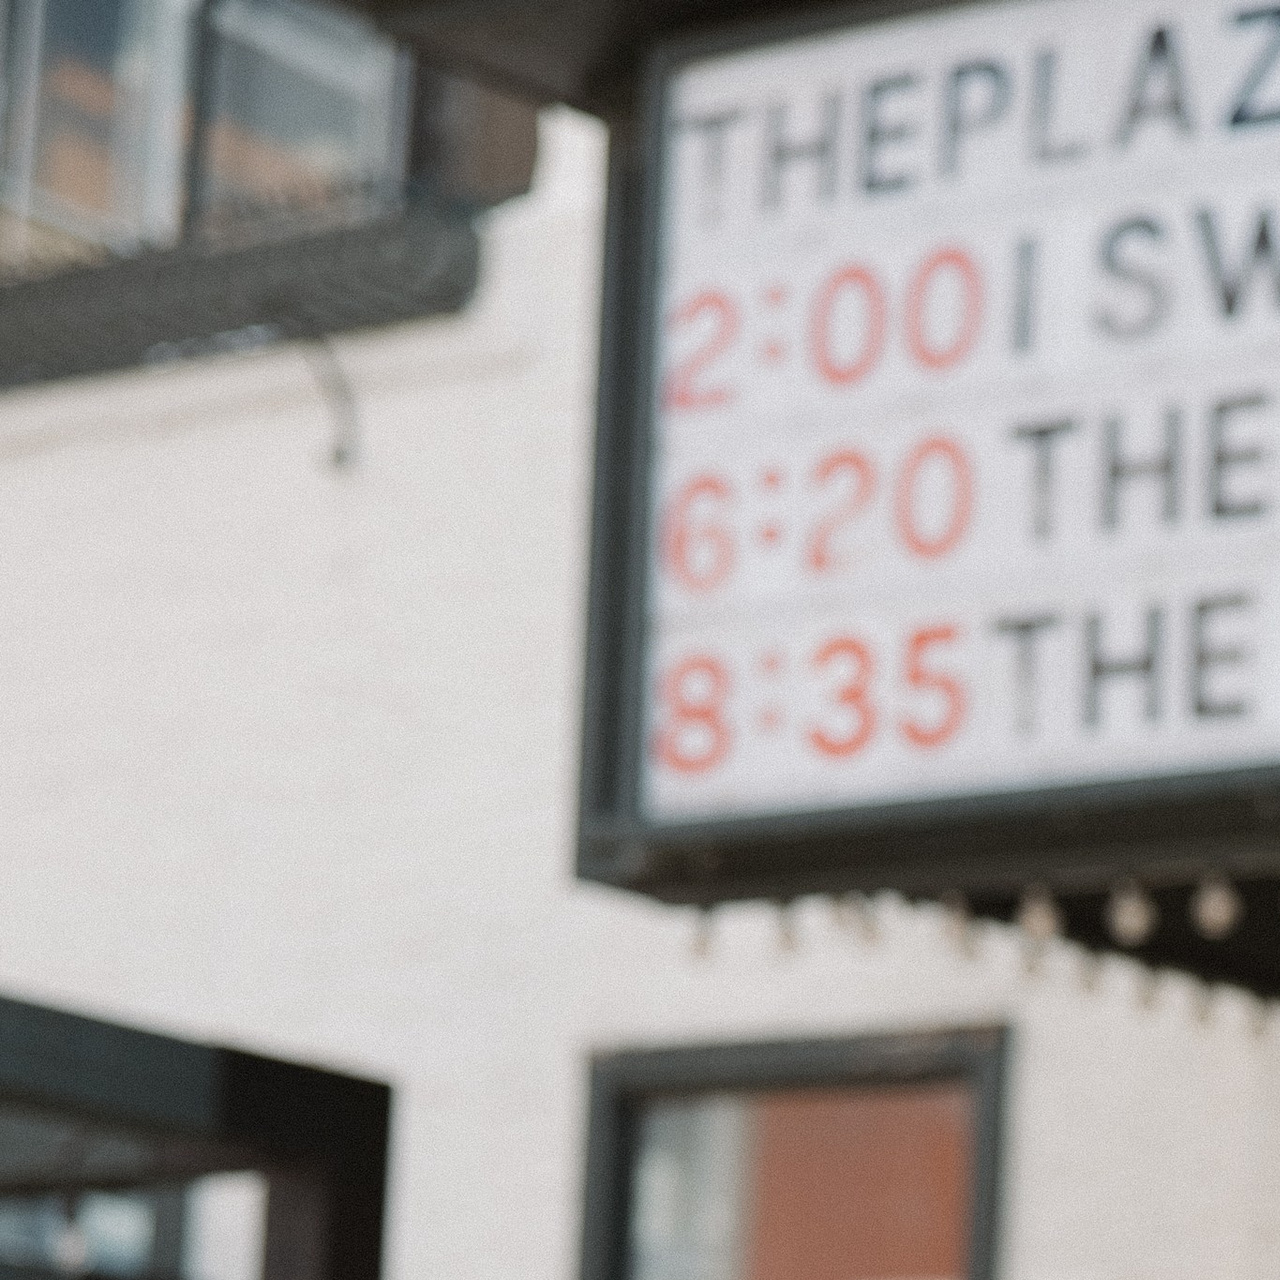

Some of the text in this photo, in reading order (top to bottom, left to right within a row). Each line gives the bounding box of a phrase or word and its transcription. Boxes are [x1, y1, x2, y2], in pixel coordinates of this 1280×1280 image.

[664, 246, 985, 410] 2:00
[1009, 235, 1039, 357] I
[661, 437, 972, 592] 6:20
[1010, 393, 1272, 540] THE
[656, 625, 968, 775] 8:35
[992, 594, 1256, 738] THE
